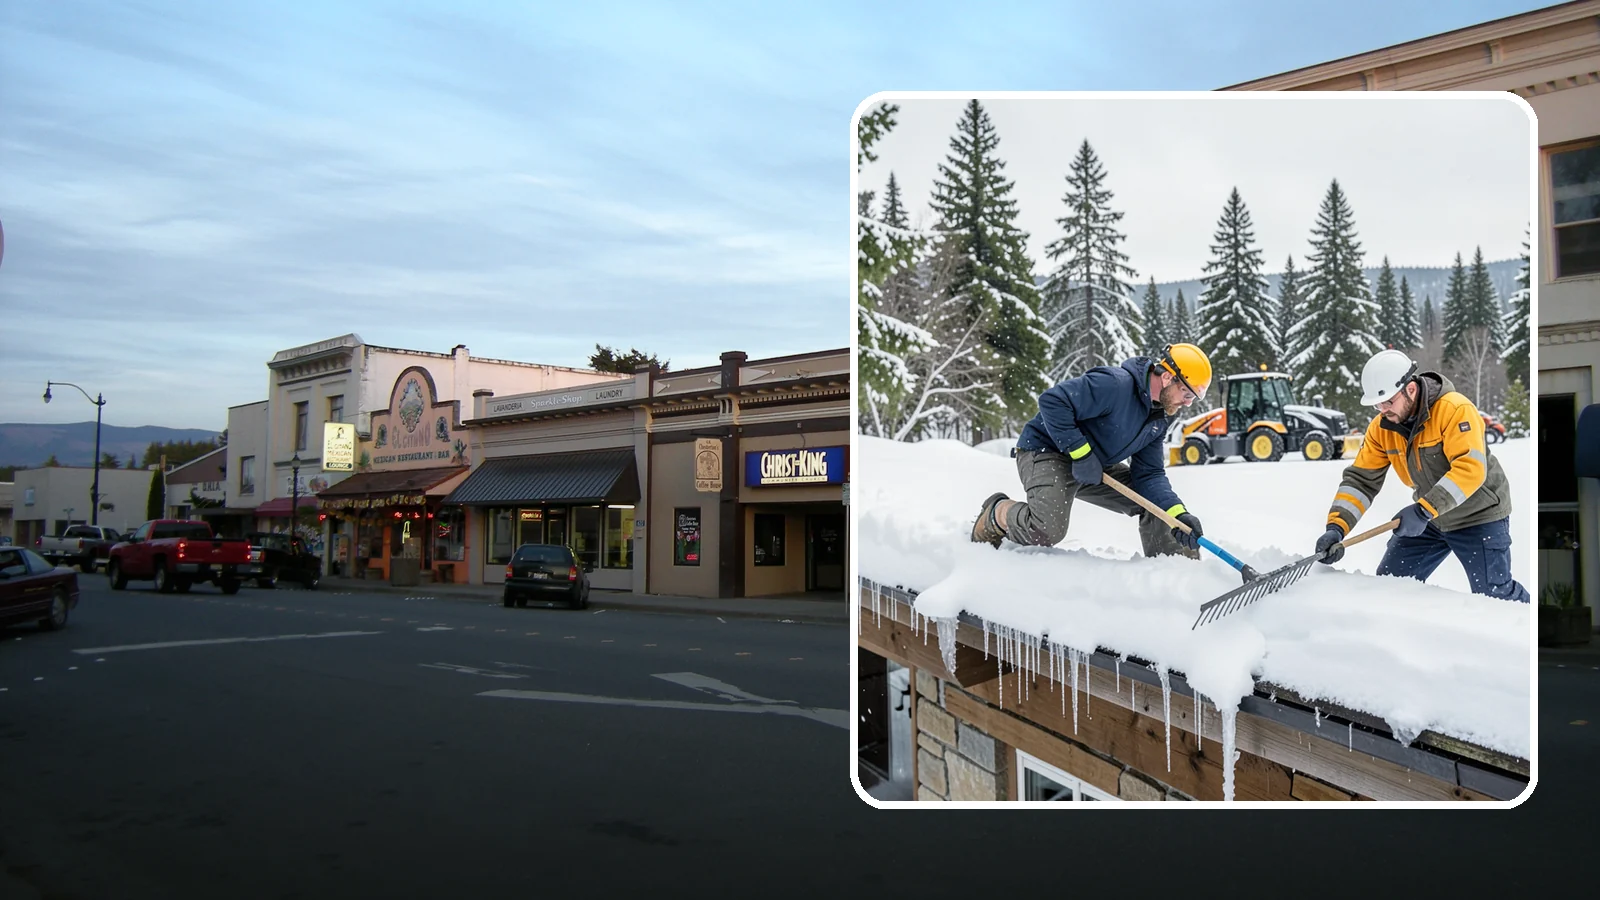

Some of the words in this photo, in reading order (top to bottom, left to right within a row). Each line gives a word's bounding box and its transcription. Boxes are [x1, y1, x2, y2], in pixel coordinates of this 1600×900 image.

[595, 389, 623, 400] LAUNDRY
[493, 402, 523, 413] LAVANDERIA
[530, 398, 561, 410] Sparkle
[561, 394, 583, 405] Shop
[373, 454, 396, 464] MEXICAN
[397, 451, 434, 462] RESTAURANT
[437, 450, 450, 459] BAR
[760, 452, 797, 478] CHRIST
[799, 450, 828, 476] KING
[696, 480, 709, 489] Coffee
